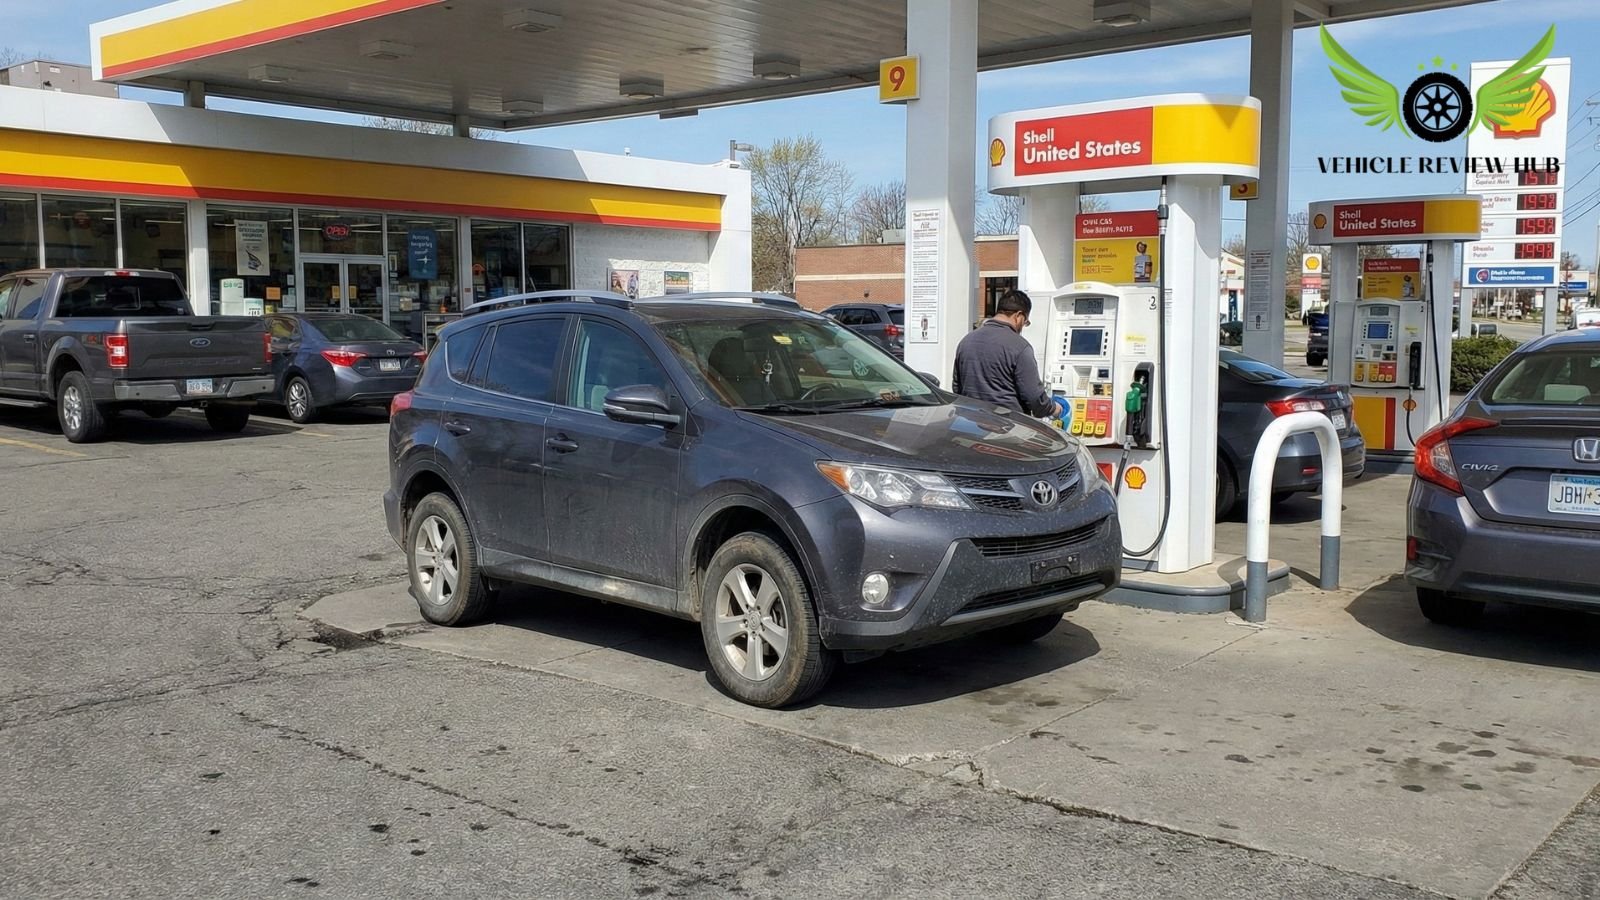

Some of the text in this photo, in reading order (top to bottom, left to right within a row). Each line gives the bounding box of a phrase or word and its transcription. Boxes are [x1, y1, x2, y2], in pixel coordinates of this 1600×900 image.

[888, 65, 905, 92] 9
[1023, 128, 1055, 144] Shell
[1024, 140, 1142, 164] United States
[1339, 218, 1417, 230] United States
